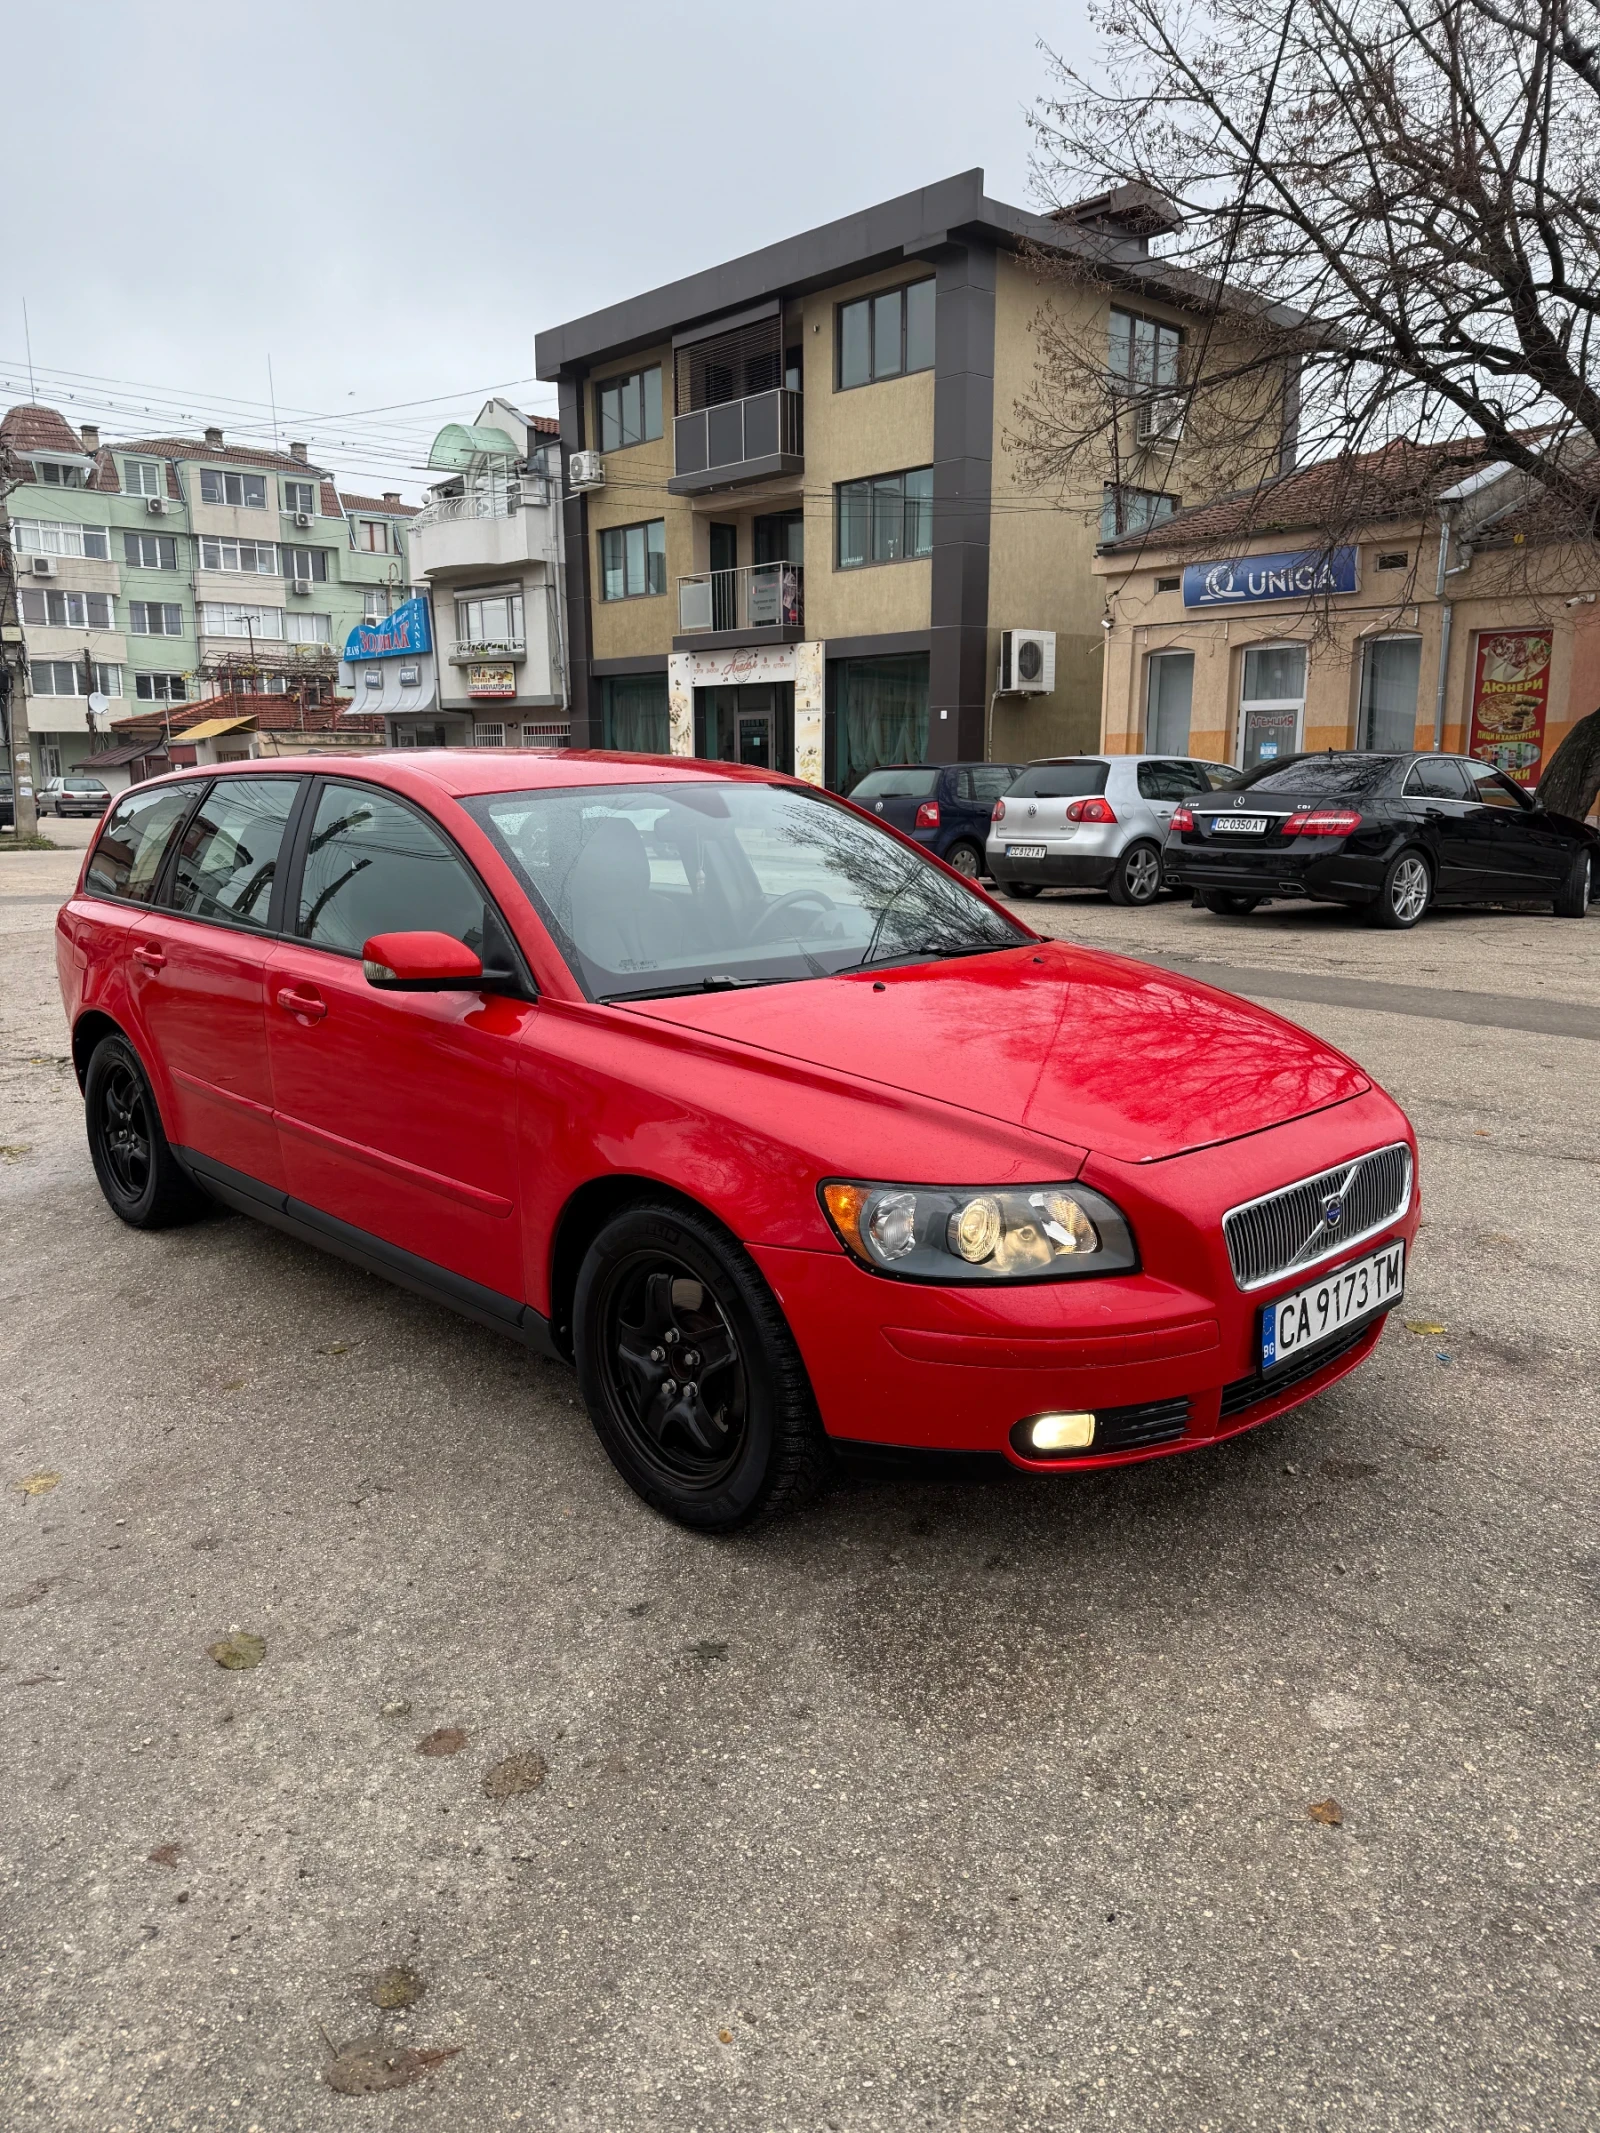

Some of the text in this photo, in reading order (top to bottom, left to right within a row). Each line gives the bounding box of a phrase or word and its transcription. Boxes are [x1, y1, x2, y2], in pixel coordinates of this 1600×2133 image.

[1481, 678, 1543, 694] ДЮНЕРИ
[1249, 714, 1294, 728] АГЕНЦИЯ
[1279, 1249, 1400, 1349] CA 9173 TM
[1263, 1342, 1275, 1358] BG
